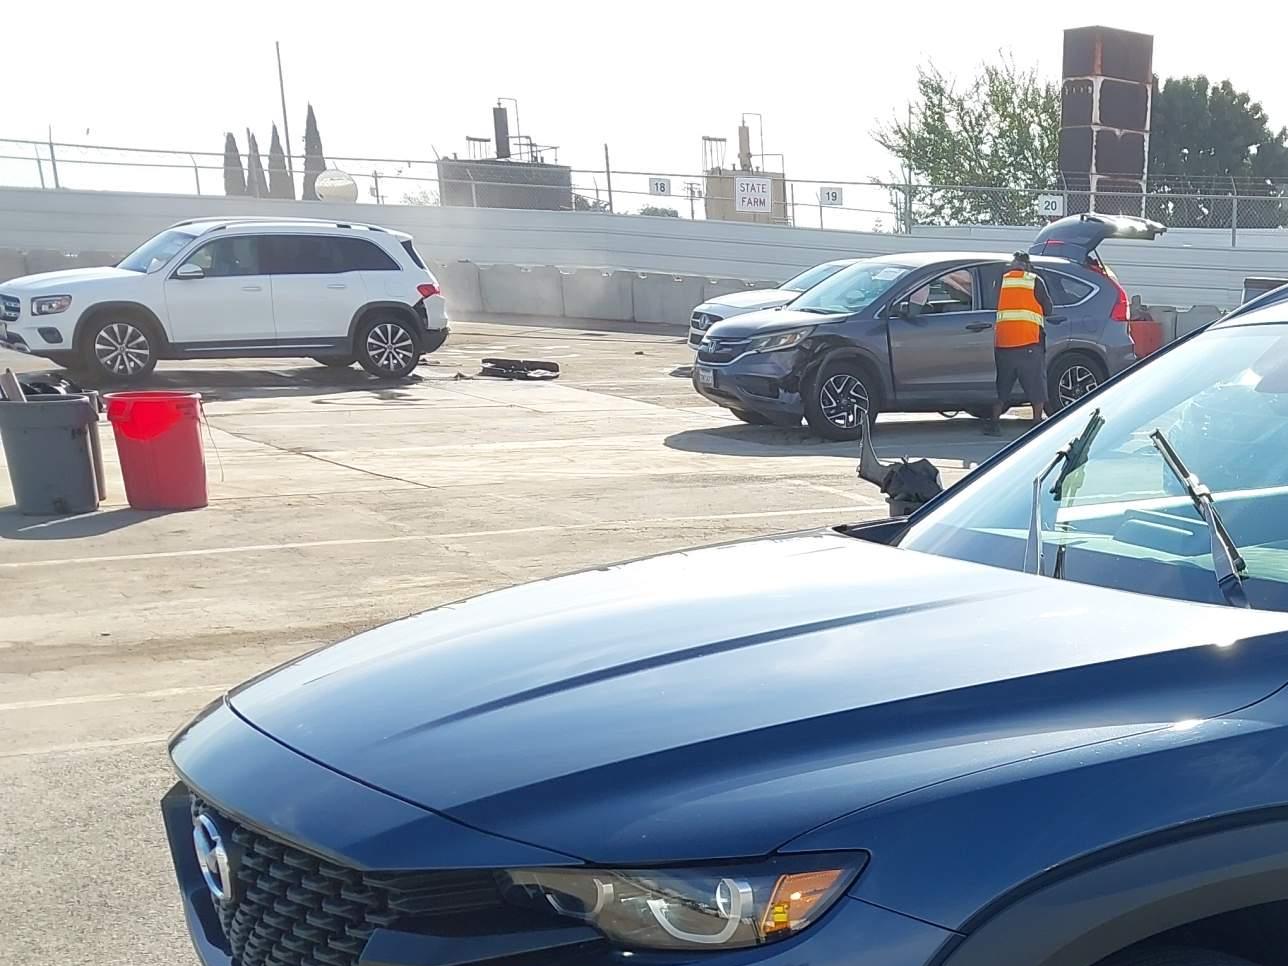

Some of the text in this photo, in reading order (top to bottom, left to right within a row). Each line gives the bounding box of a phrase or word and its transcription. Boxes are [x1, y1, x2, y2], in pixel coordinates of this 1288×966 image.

[655, 182, 666, 193] 18
[740, 182, 767, 193] STATE
[826, 191, 837, 202] 19
[741, 197, 766, 208] FARM
[1044, 200, 1057, 211] 20
